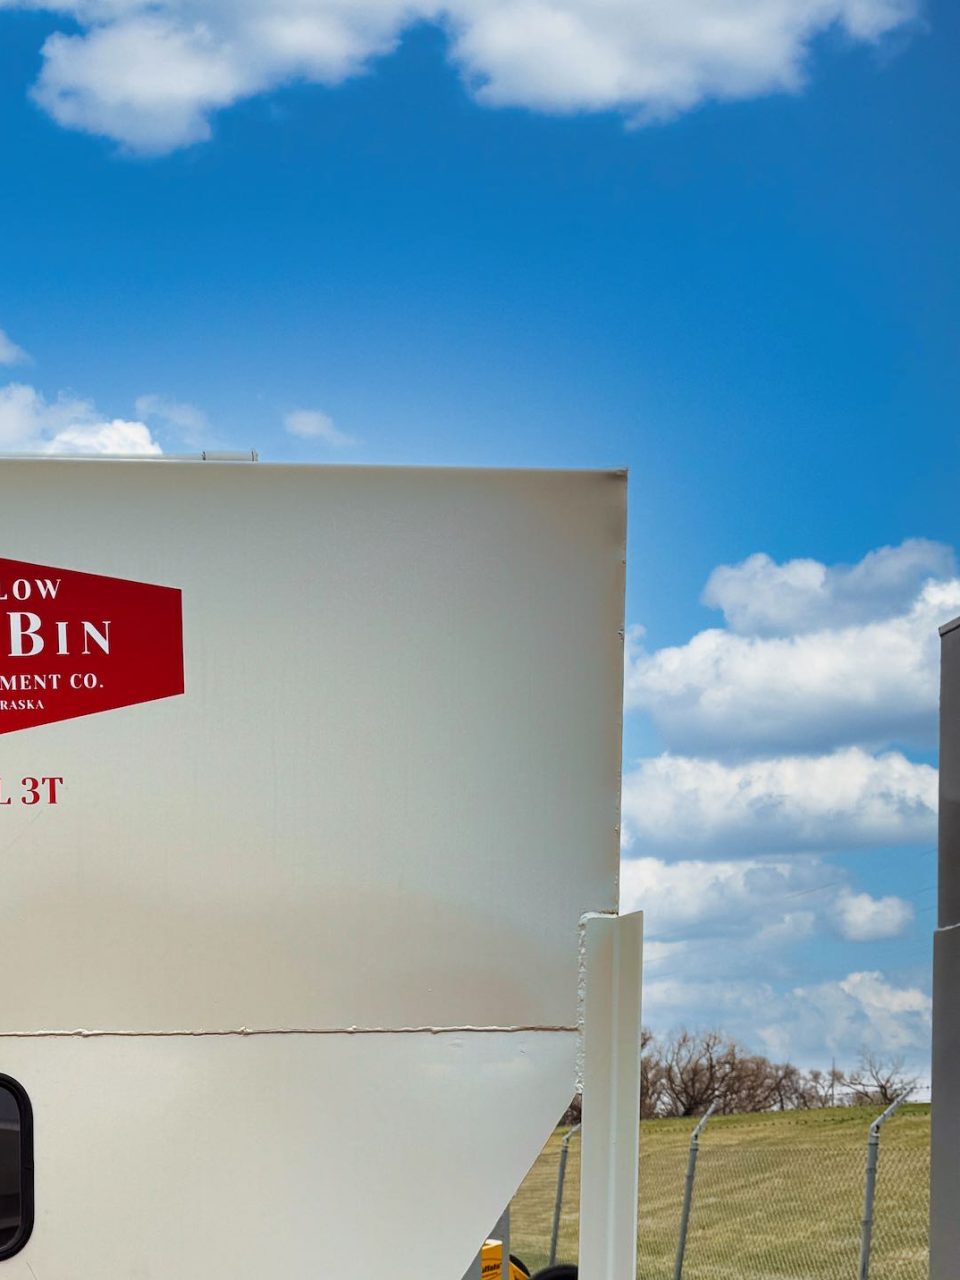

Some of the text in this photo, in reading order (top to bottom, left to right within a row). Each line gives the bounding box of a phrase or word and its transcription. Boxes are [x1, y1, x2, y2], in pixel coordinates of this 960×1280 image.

[6, 611, 112, 657] BIN
[69, 672, 105, 690] CO.
[21, 776, 64, 805] 3T
